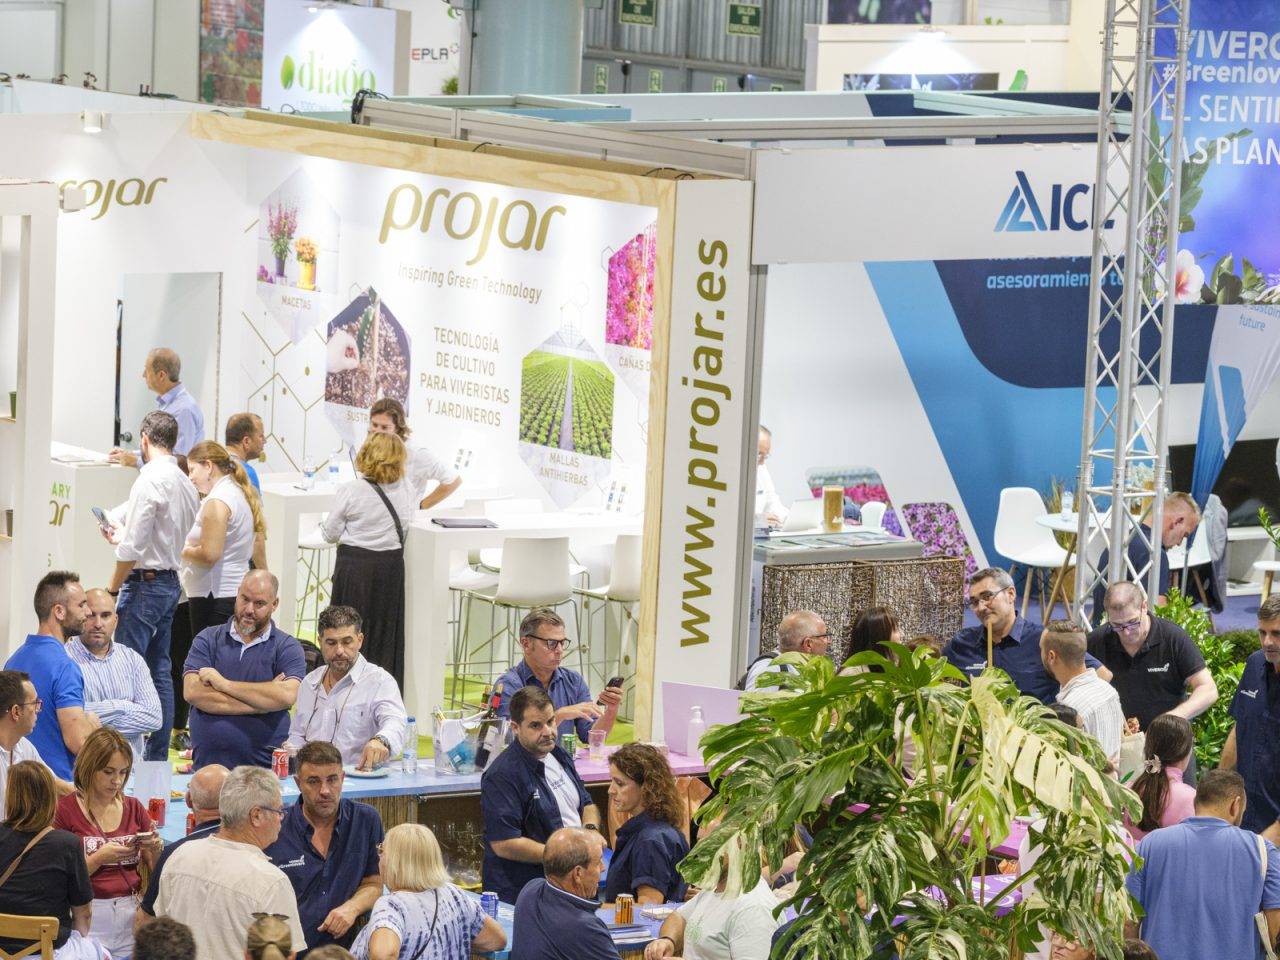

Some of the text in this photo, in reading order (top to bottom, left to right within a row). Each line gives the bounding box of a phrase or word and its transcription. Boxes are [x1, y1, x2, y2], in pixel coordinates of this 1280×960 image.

[1199, 94, 1280, 124] SENTI
[378, 183, 567, 266] projar
[398, 262, 543, 302] Inspiring Green Technology
[987, 271, 1104, 290] asesoramien
[433, 327, 500, 354] TECNOLOGÍA
[435, 352, 496, 377] DE CULTIVO
[420, 373, 511, 404] PARA VIVERISTAS
[426, 398, 501, 427] Y JARDINEROS
[680, 238, 732, 648] www.projar.es
[549, 453, 580, 468] MALLAS
[539, 467, 588, 486] ANTIHIERBAS
